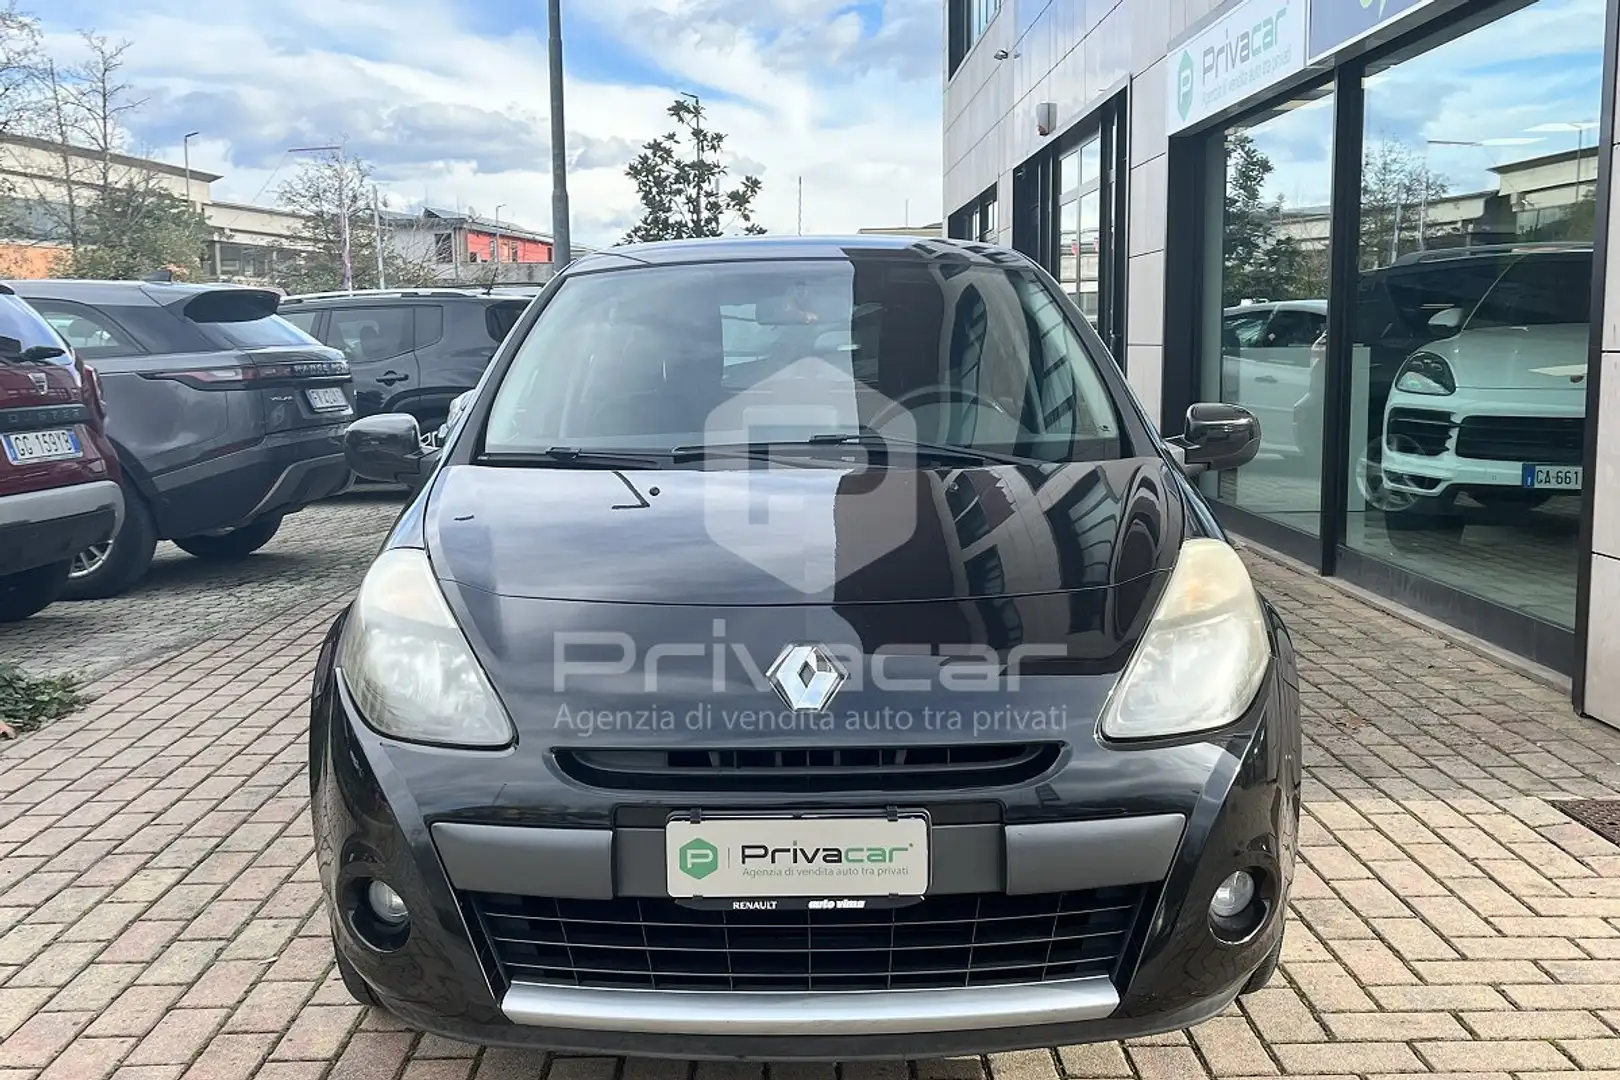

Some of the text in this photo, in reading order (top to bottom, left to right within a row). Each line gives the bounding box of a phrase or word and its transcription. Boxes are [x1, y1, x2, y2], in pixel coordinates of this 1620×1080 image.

[1202, 7, 1287, 86] Privacar
[8, 409, 81, 423] DUSTER
[741, 840, 909, 865] Privacar
[742, 868, 783, 878] Agenzia
[784, 867, 794, 877] di
[836, 867, 859, 877] auto
[861, 867, 875, 877] tra
[877, 867, 909, 878] privati
[732, 901, 778, 910] RENAULT
[808, 899, 836, 910] auto
